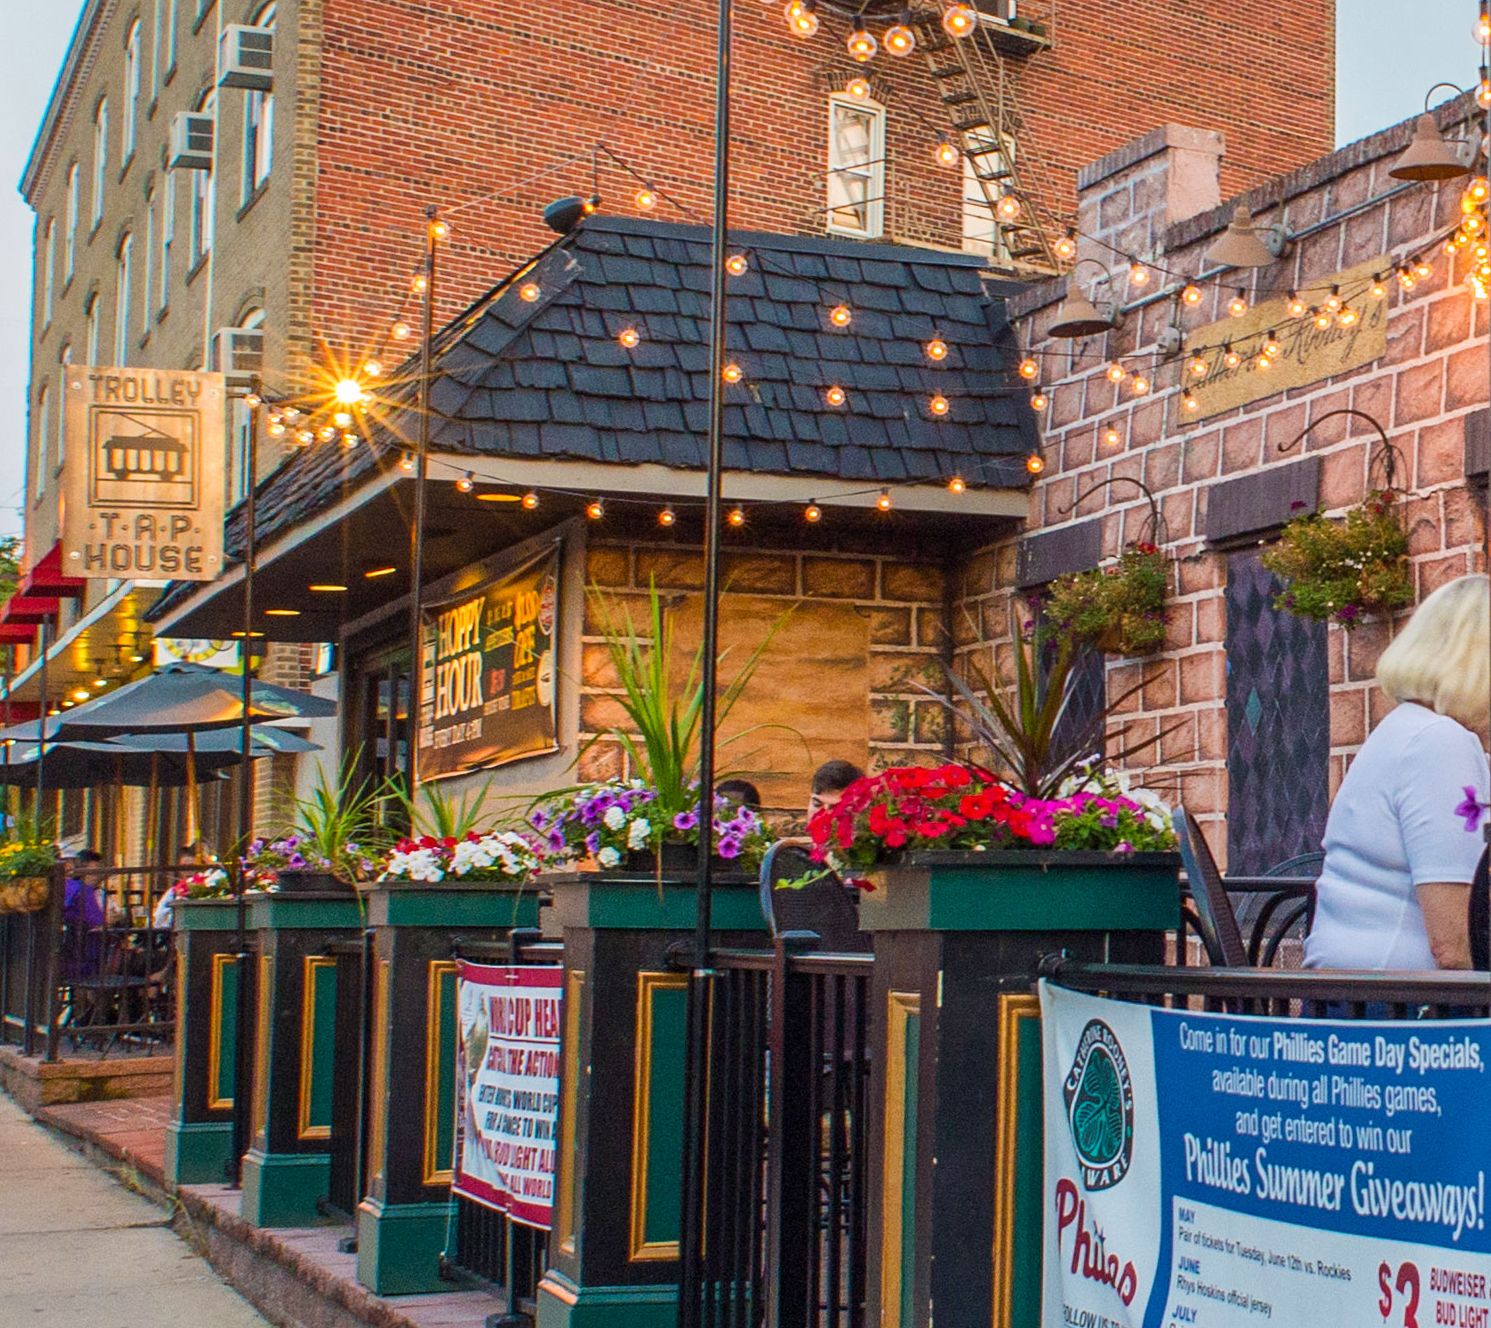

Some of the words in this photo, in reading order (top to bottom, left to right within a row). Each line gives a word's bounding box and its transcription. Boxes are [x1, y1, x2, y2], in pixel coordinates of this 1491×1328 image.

[89, 374, 202, 406] TROLLEY
[84, 543, 203, 573] HOUSE
[437, 596, 486, 660] HOPPY
[435, 651, 483, 720] HOUR
[509, 997, 531, 1037] CUP
[1179, 1022, 1213, 1053] Come
[1215, 1027, 1227, 1047] in
[1230, 1027, 1246, 1051] for
[1249, 1035, 1271, 1055] our
[1273, 1031, 1324, 1063] Phillies
[1327, 1034, 1371, 1067] Game
[1375, 1036, 1405, 1075] Day
[1409, 1036, 1484, 1075] Specials,
[1212, 1069, 1264, 1098] available
[1267, 1073, 1309, 1109] during
[1312, 1075, 1327, 1105] all
[1331, 1075, 1381, 1109] Phillies
[1385, 1086, 1441, 1118] games,
[1236, 1108, 1259, 1135] and
[1262, 1114, 1282, 1144] get
[1285, 1114, 1335, 1147] entered
[1339, 1118, 1353, 1148] to
[1356, 1121, 1384, 1151] win
[1387, 1129, 1412, 1154] our
[1183, 1132, 1251, 1195] Phillies
[1256, 1147, 1344, 1211] Summer
[1351, 1160, 1484, 1241] Giveaways!
[1178, 1206, 1196, 1224] MAY
[1178, 1225, 1191, 1245] Pair
[1201, 1231, 1224, 1254] tickets
[1224, 1237, 1235, 1255] for
[1235, 1241, 1267, 1269] Tuesday,
[1267, 1248, 1285, 1267] June
[1286, 1251, 1303, 1272] 12th
[1317, 1260, 1352, 1282] Rockies
[1178, 1255, 1201, 1275] JUNE
[1176, 1274, 1196, 1295] Rhys
[1197, 1279, 1225, 1302] Hoskins
[1227, 1288, 1249, 1309] official
[1249, 1291, 1273, 1319] jersey
[1430, 1267, 1486, 1299] BUDWEISER
[1171, 1305, 1197, 1323] JULY
[1436, 1300, 1456, 1326] BUD
